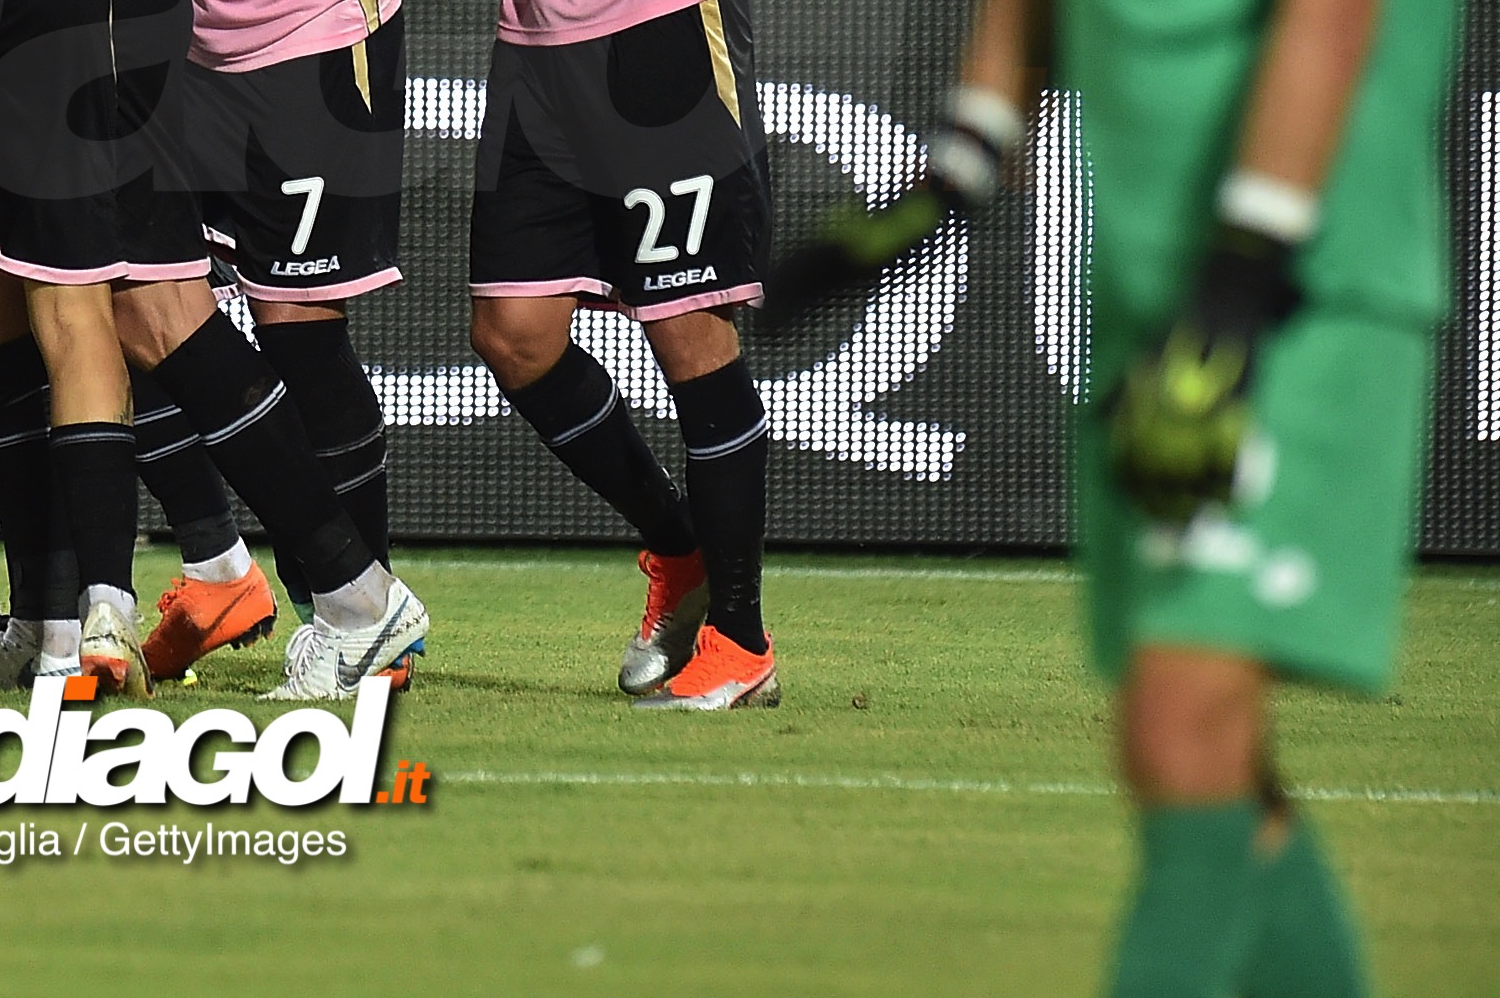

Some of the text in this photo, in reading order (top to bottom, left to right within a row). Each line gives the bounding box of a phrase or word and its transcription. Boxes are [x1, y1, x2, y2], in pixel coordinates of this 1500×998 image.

[280, 175, 325, 255] 7
[623, 174, 714, 264] 27
[269, 255, 341, 277] LEGEA
[643, 265, 718, 291] LEGEA
